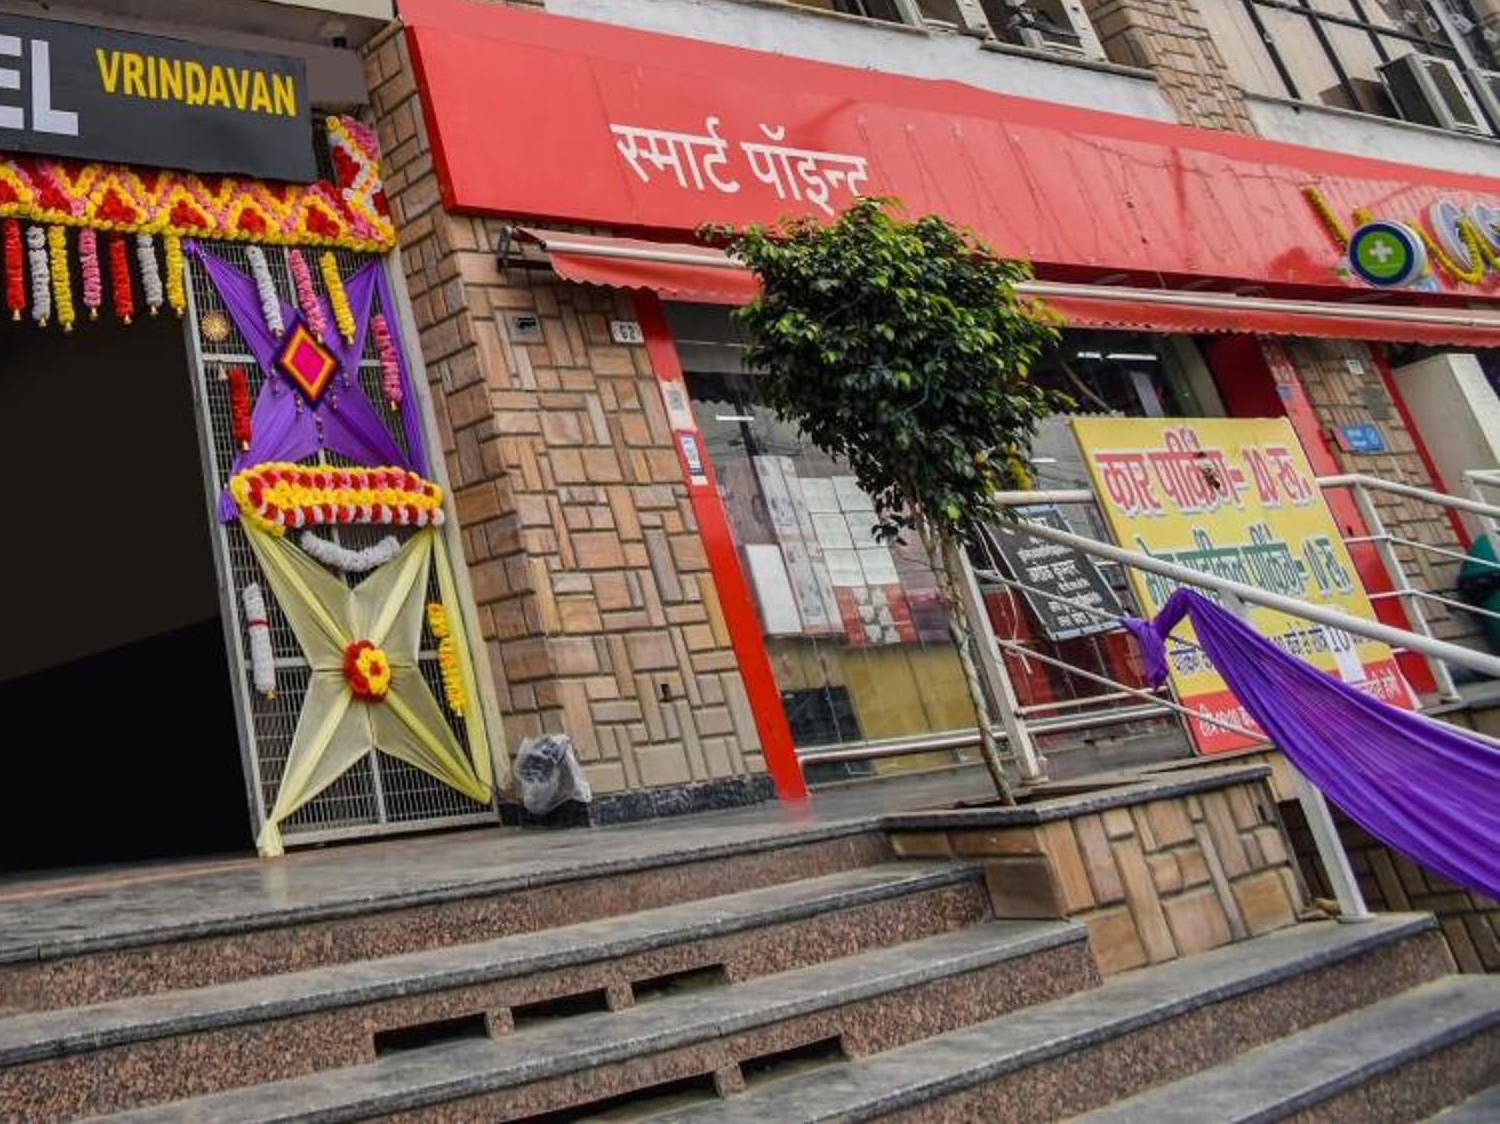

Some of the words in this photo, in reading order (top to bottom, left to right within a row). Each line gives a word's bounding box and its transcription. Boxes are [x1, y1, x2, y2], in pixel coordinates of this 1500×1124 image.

[95, 46, 298, 118] VRINDAVAN
[609, 115, 741, 194] स्मार्ट
[739, 122, 869, 217] पॉइन्ट
[1094, 451, 1162, 512] कार
